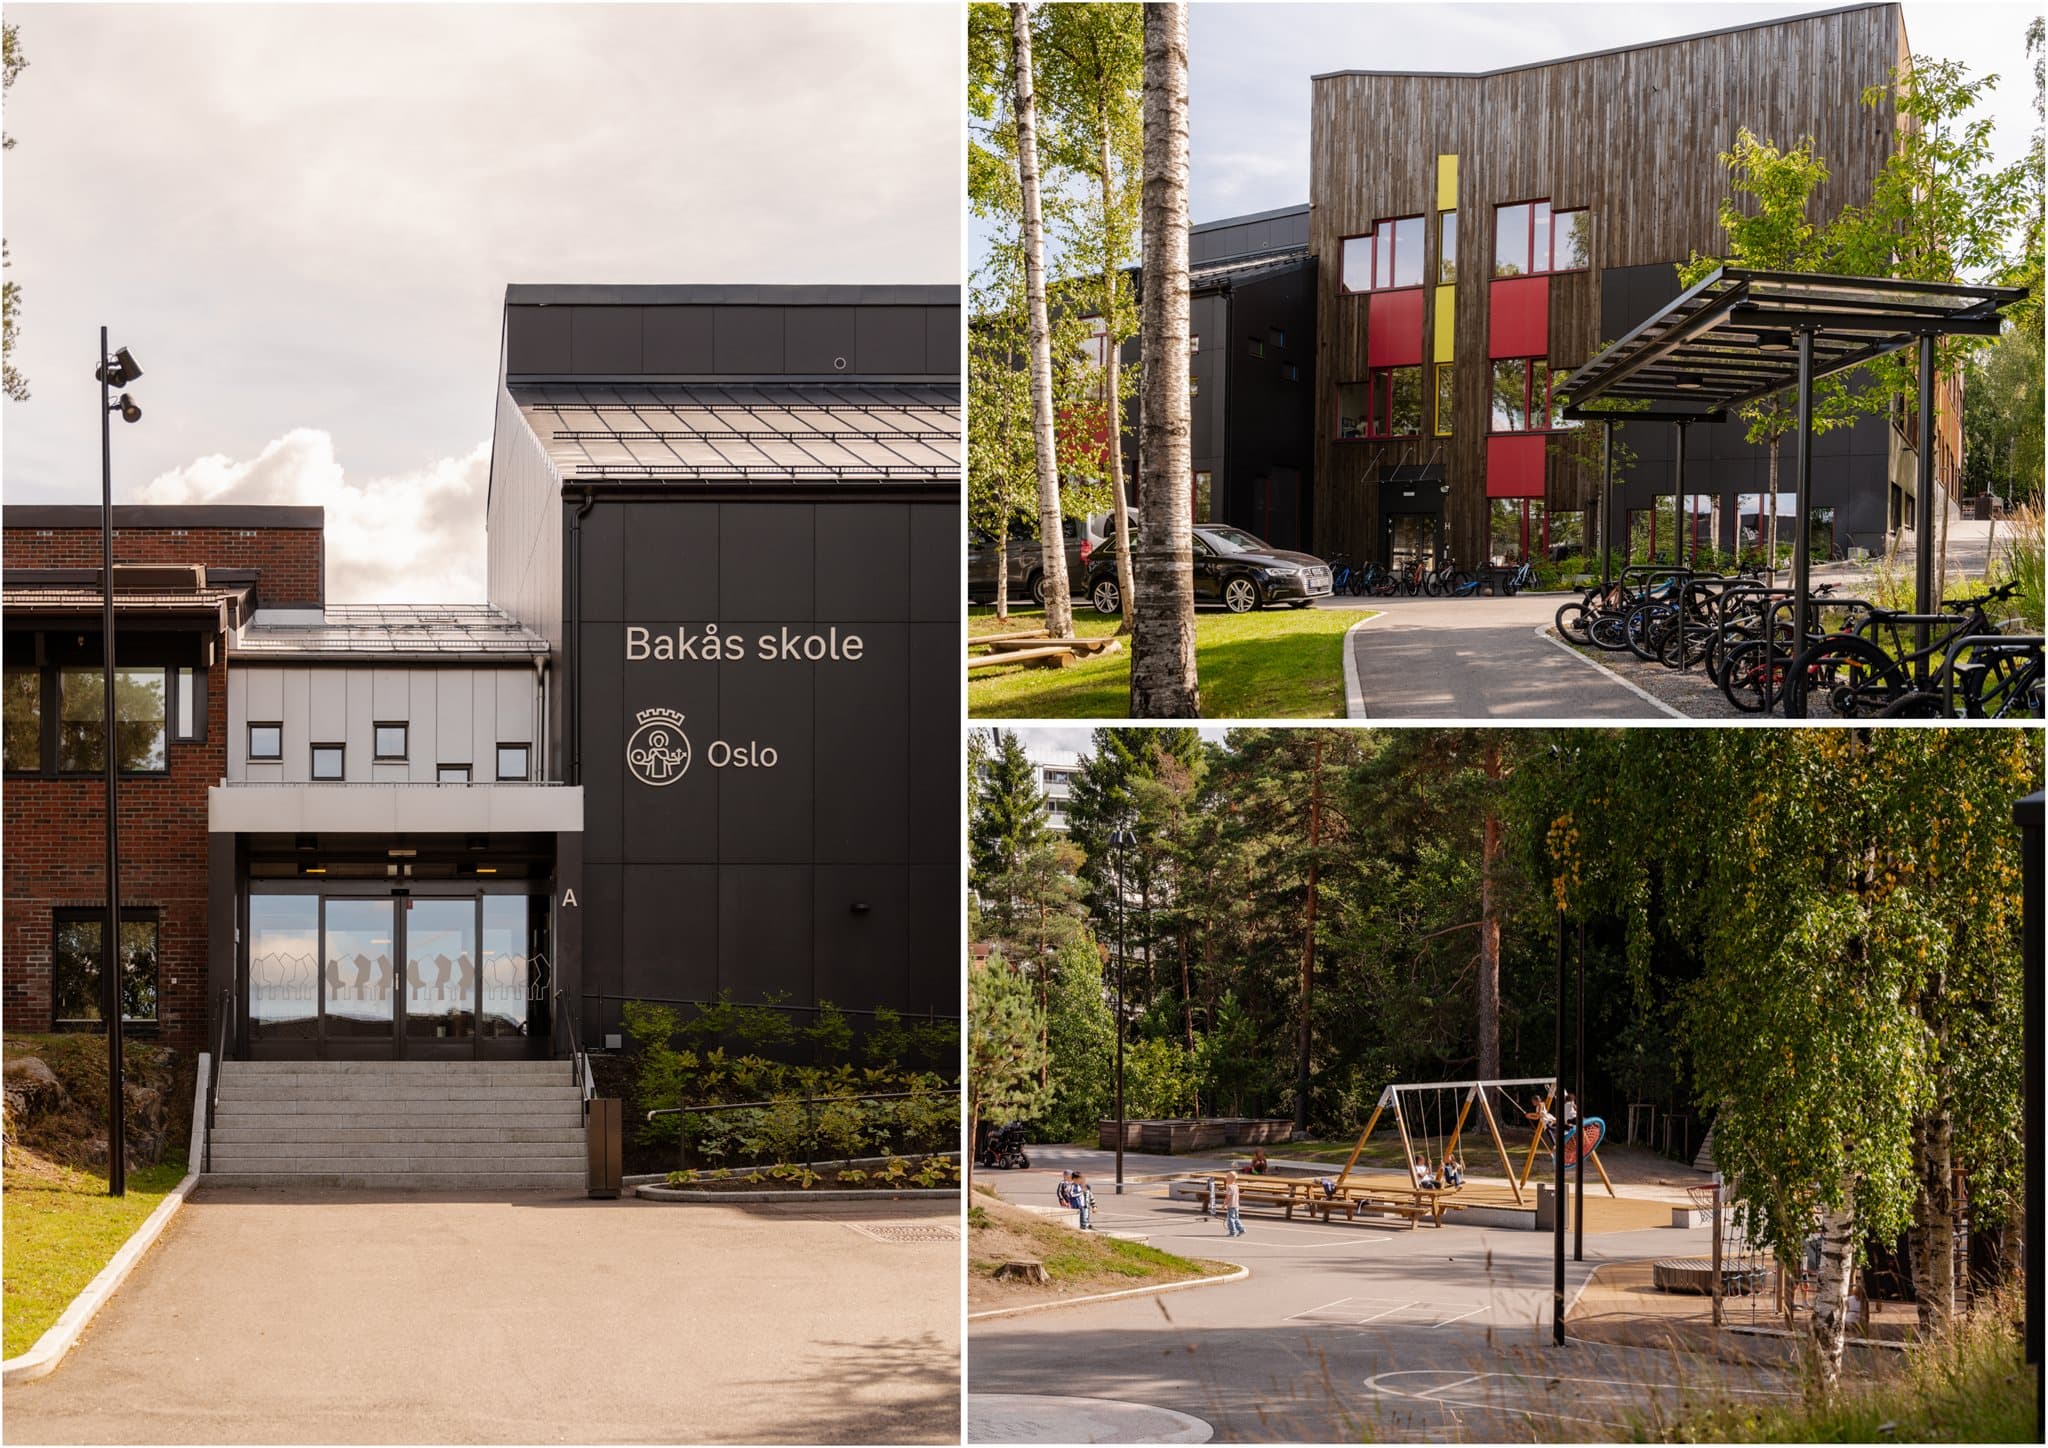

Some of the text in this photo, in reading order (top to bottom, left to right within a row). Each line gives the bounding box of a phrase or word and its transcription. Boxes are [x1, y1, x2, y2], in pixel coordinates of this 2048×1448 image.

[626, 623, 864, 661] Bakås skole
[707, 740, 778, 768] Oslo
[562, 888, 578, 907] A
